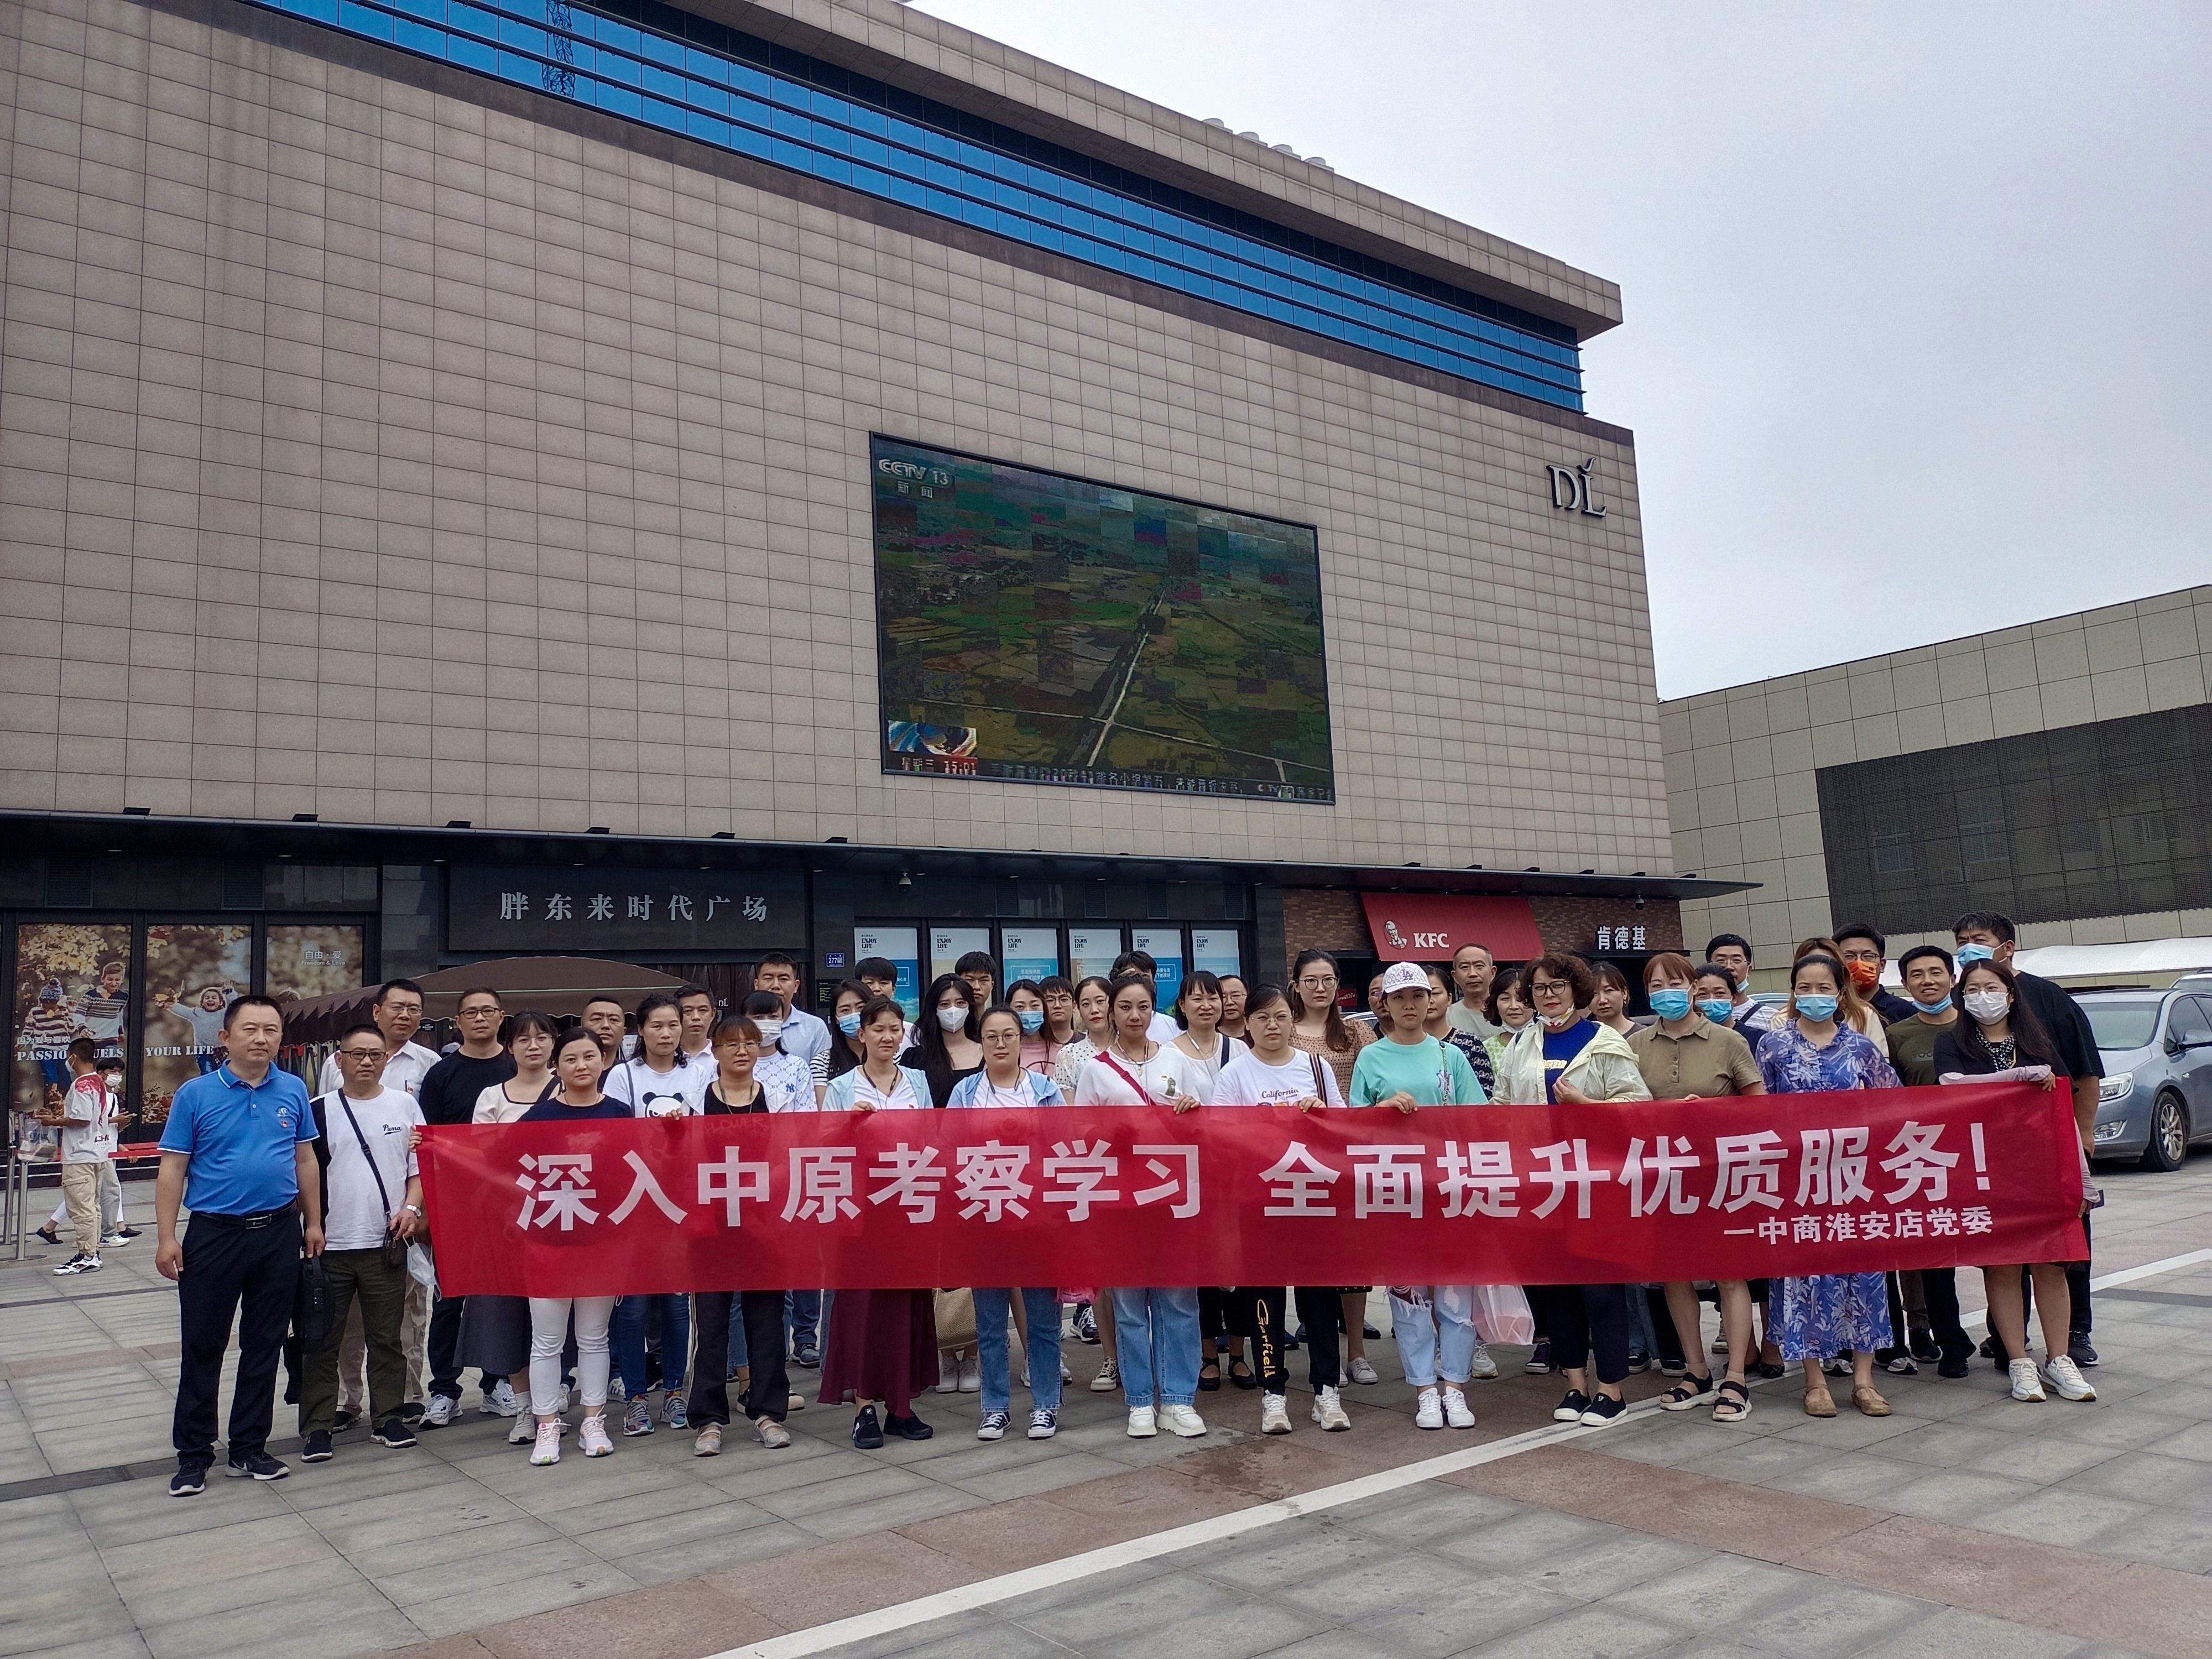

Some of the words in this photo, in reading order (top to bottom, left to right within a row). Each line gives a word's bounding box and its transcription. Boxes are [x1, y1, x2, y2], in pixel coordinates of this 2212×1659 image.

[879, 458, 927, 479] CCTV
[932, 471, 948, 486] 13
[500, 891, 767, 922] 胖东来时代广场
[1413, 933, 1449, 948] KFC
[1598, 926, 1646, 950] 肯德基
[17, 1036, 71, 1045] 因为爱与喜欢
[17, 1050, 67, 1061] PASSIO
[145, 1046, 182, 1056] YOUR
[186, 1045, 214, 1055] LIFE
[1261, 1087, 1299, 1101] California
[515, 1138, 1201, 1232] 深入中原考察学习
[1258, 1120, 1991, 1219] 全面提升优质服务!
[1257, 1300, 1276, 1378] Garfield
